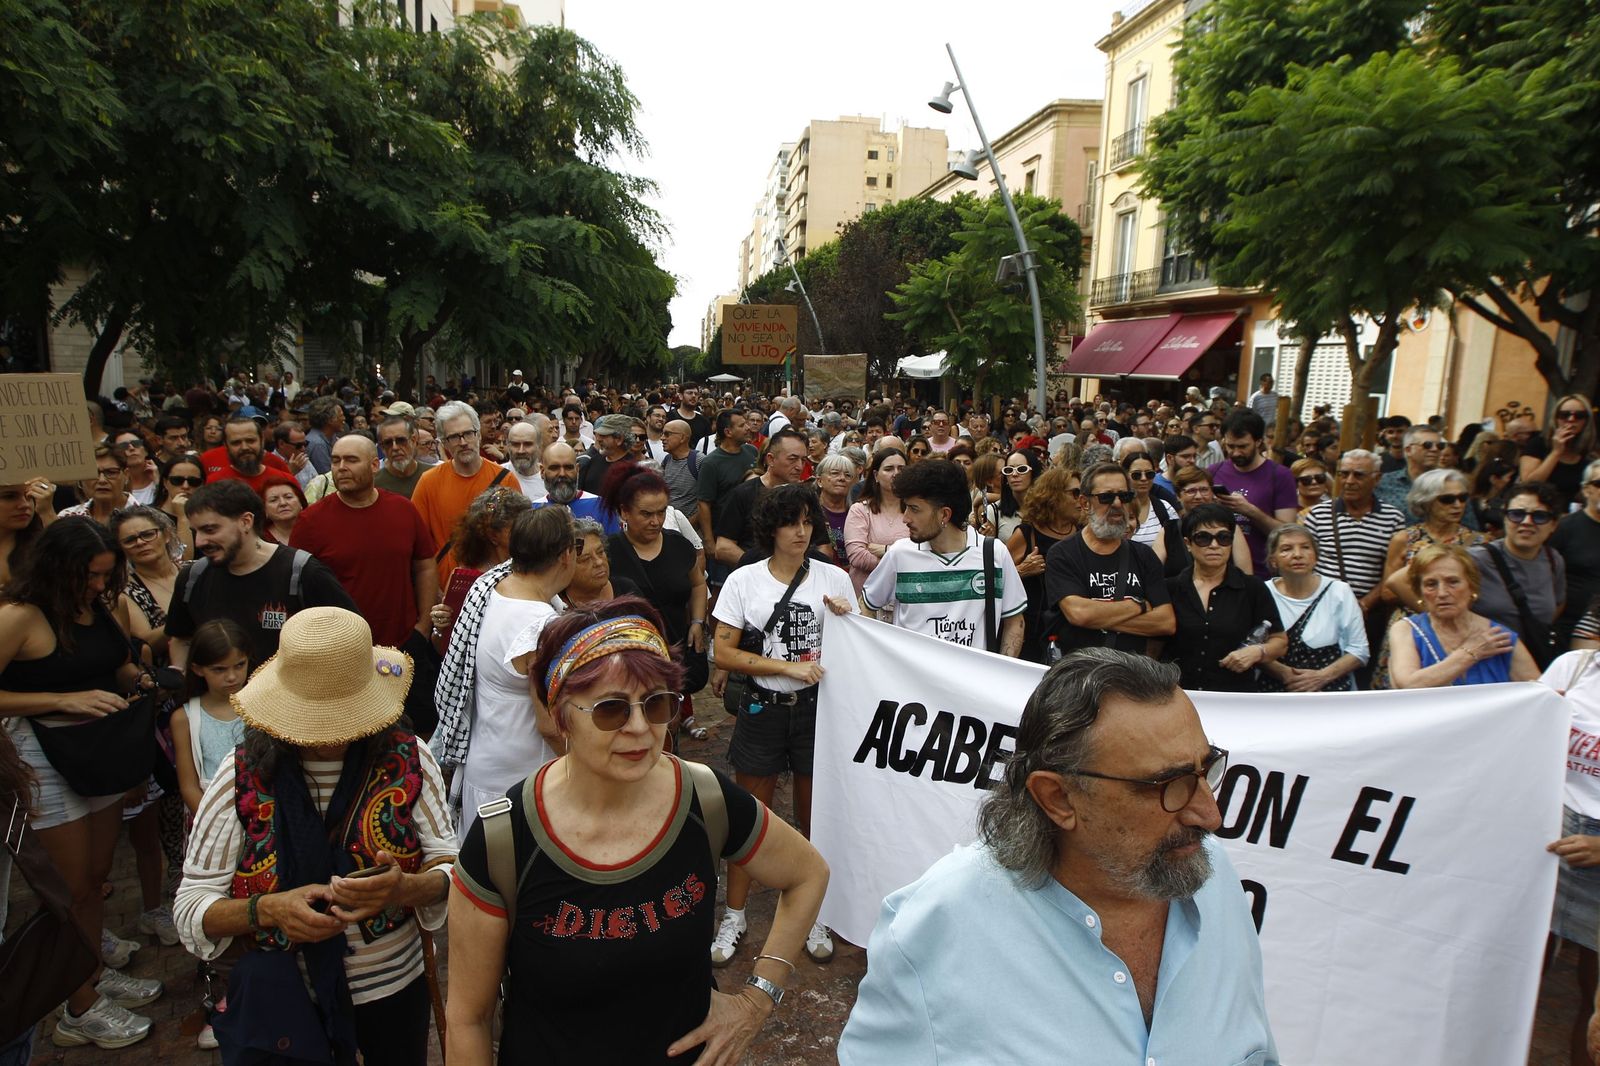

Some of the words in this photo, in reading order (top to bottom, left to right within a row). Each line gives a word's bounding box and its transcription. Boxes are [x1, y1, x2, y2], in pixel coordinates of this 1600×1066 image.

[732, 307, 760, 320] QUE
[767, 308, 781, 319] LA
[733, 322, 787, 333] VIVIENDA
[728, 333, 746, 343] NO
[752, 333, 774, 343] SEA
[779, 333, 795, 343] UN
[741, 344, 780, 358] LUJO
[0, 381, 78, 407] NDECENTE.
[14, 413, 38, 438] SIN
[42, 412, 79, 436] CASA
[15, 445, 38, 470] SIN
[44, 441, 86, 467] GENTE
[264, 612, 284, 620] IDLE
[1567, 760, 1600, 778] ATHE
[853, 699, 1020, 791] ACABE
[1213, 763, 1310, 849] ON
[1331, 786, 1417, 875] EL
